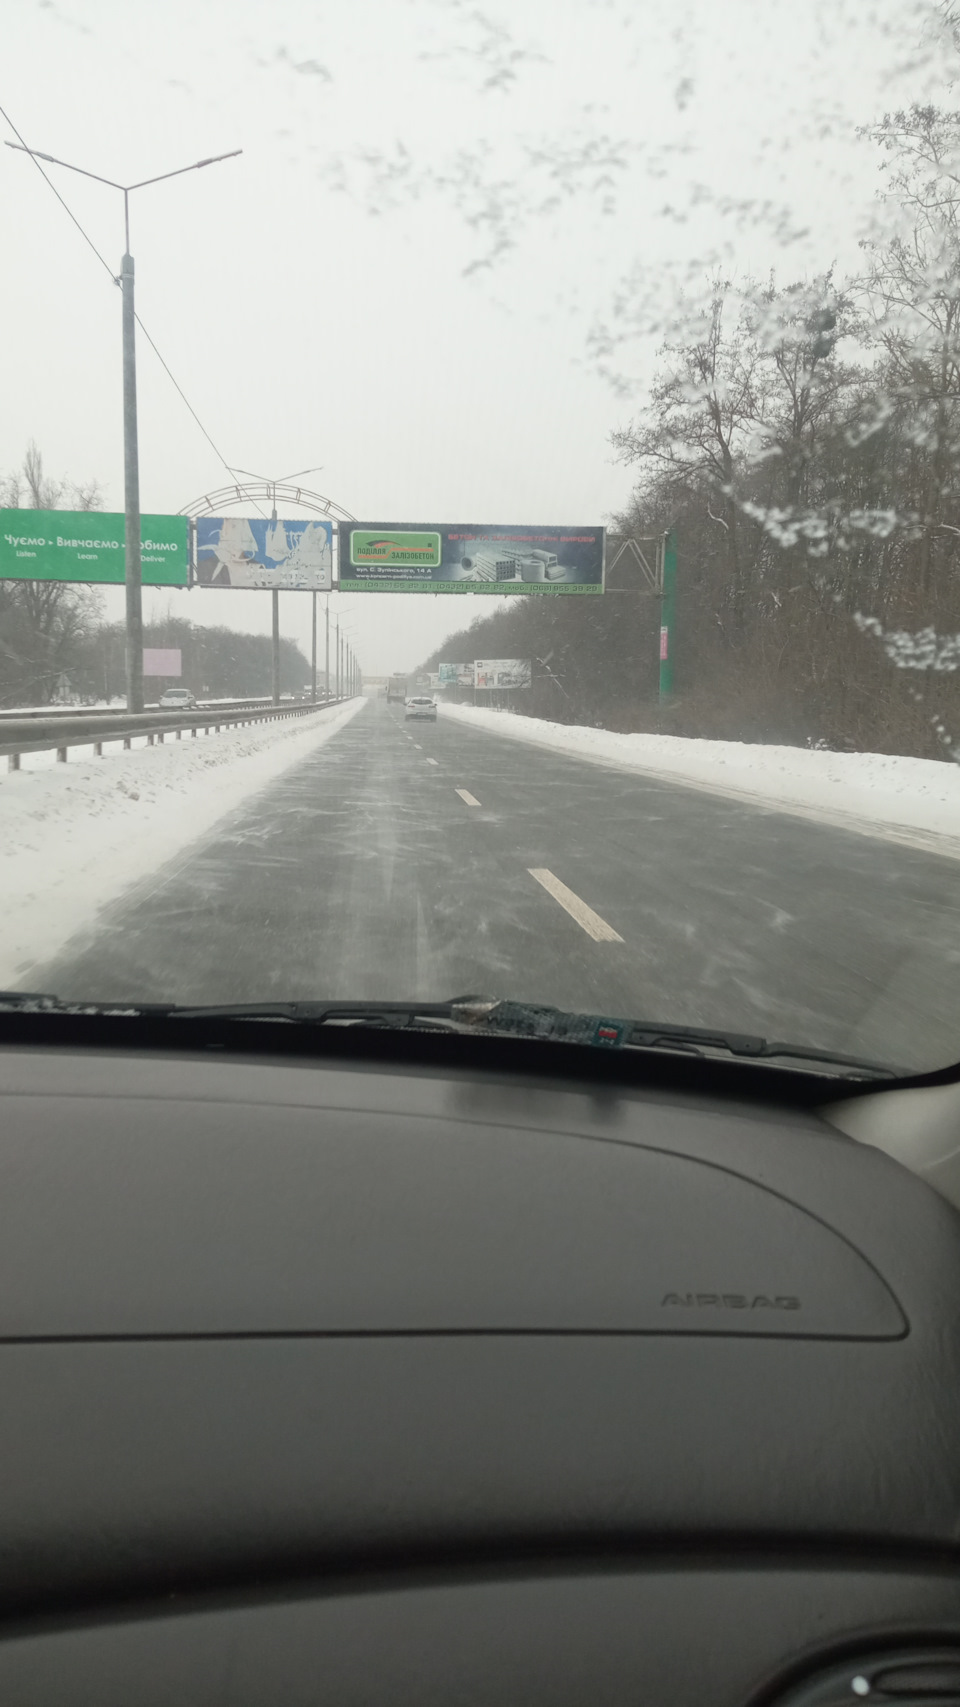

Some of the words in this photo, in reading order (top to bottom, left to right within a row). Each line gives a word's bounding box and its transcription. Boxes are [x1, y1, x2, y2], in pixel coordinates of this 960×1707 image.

[4, 534, 46, 547] Чуємо
[56, 536, 119, 549] Вивчаємо
[140, 539, 178, 551] обимо
[16, 550, 37, 558] Listen
[77, 552, 98, 560] Learn
[140, 554, 166, 563] Deliver
[357, 547, 386, 555] ПОДІЛЛЯ
[391, 552, 434, 560] ЗАЛІЗОБЕТОН
[660, 1292, 801, 1311] AIRBAG
